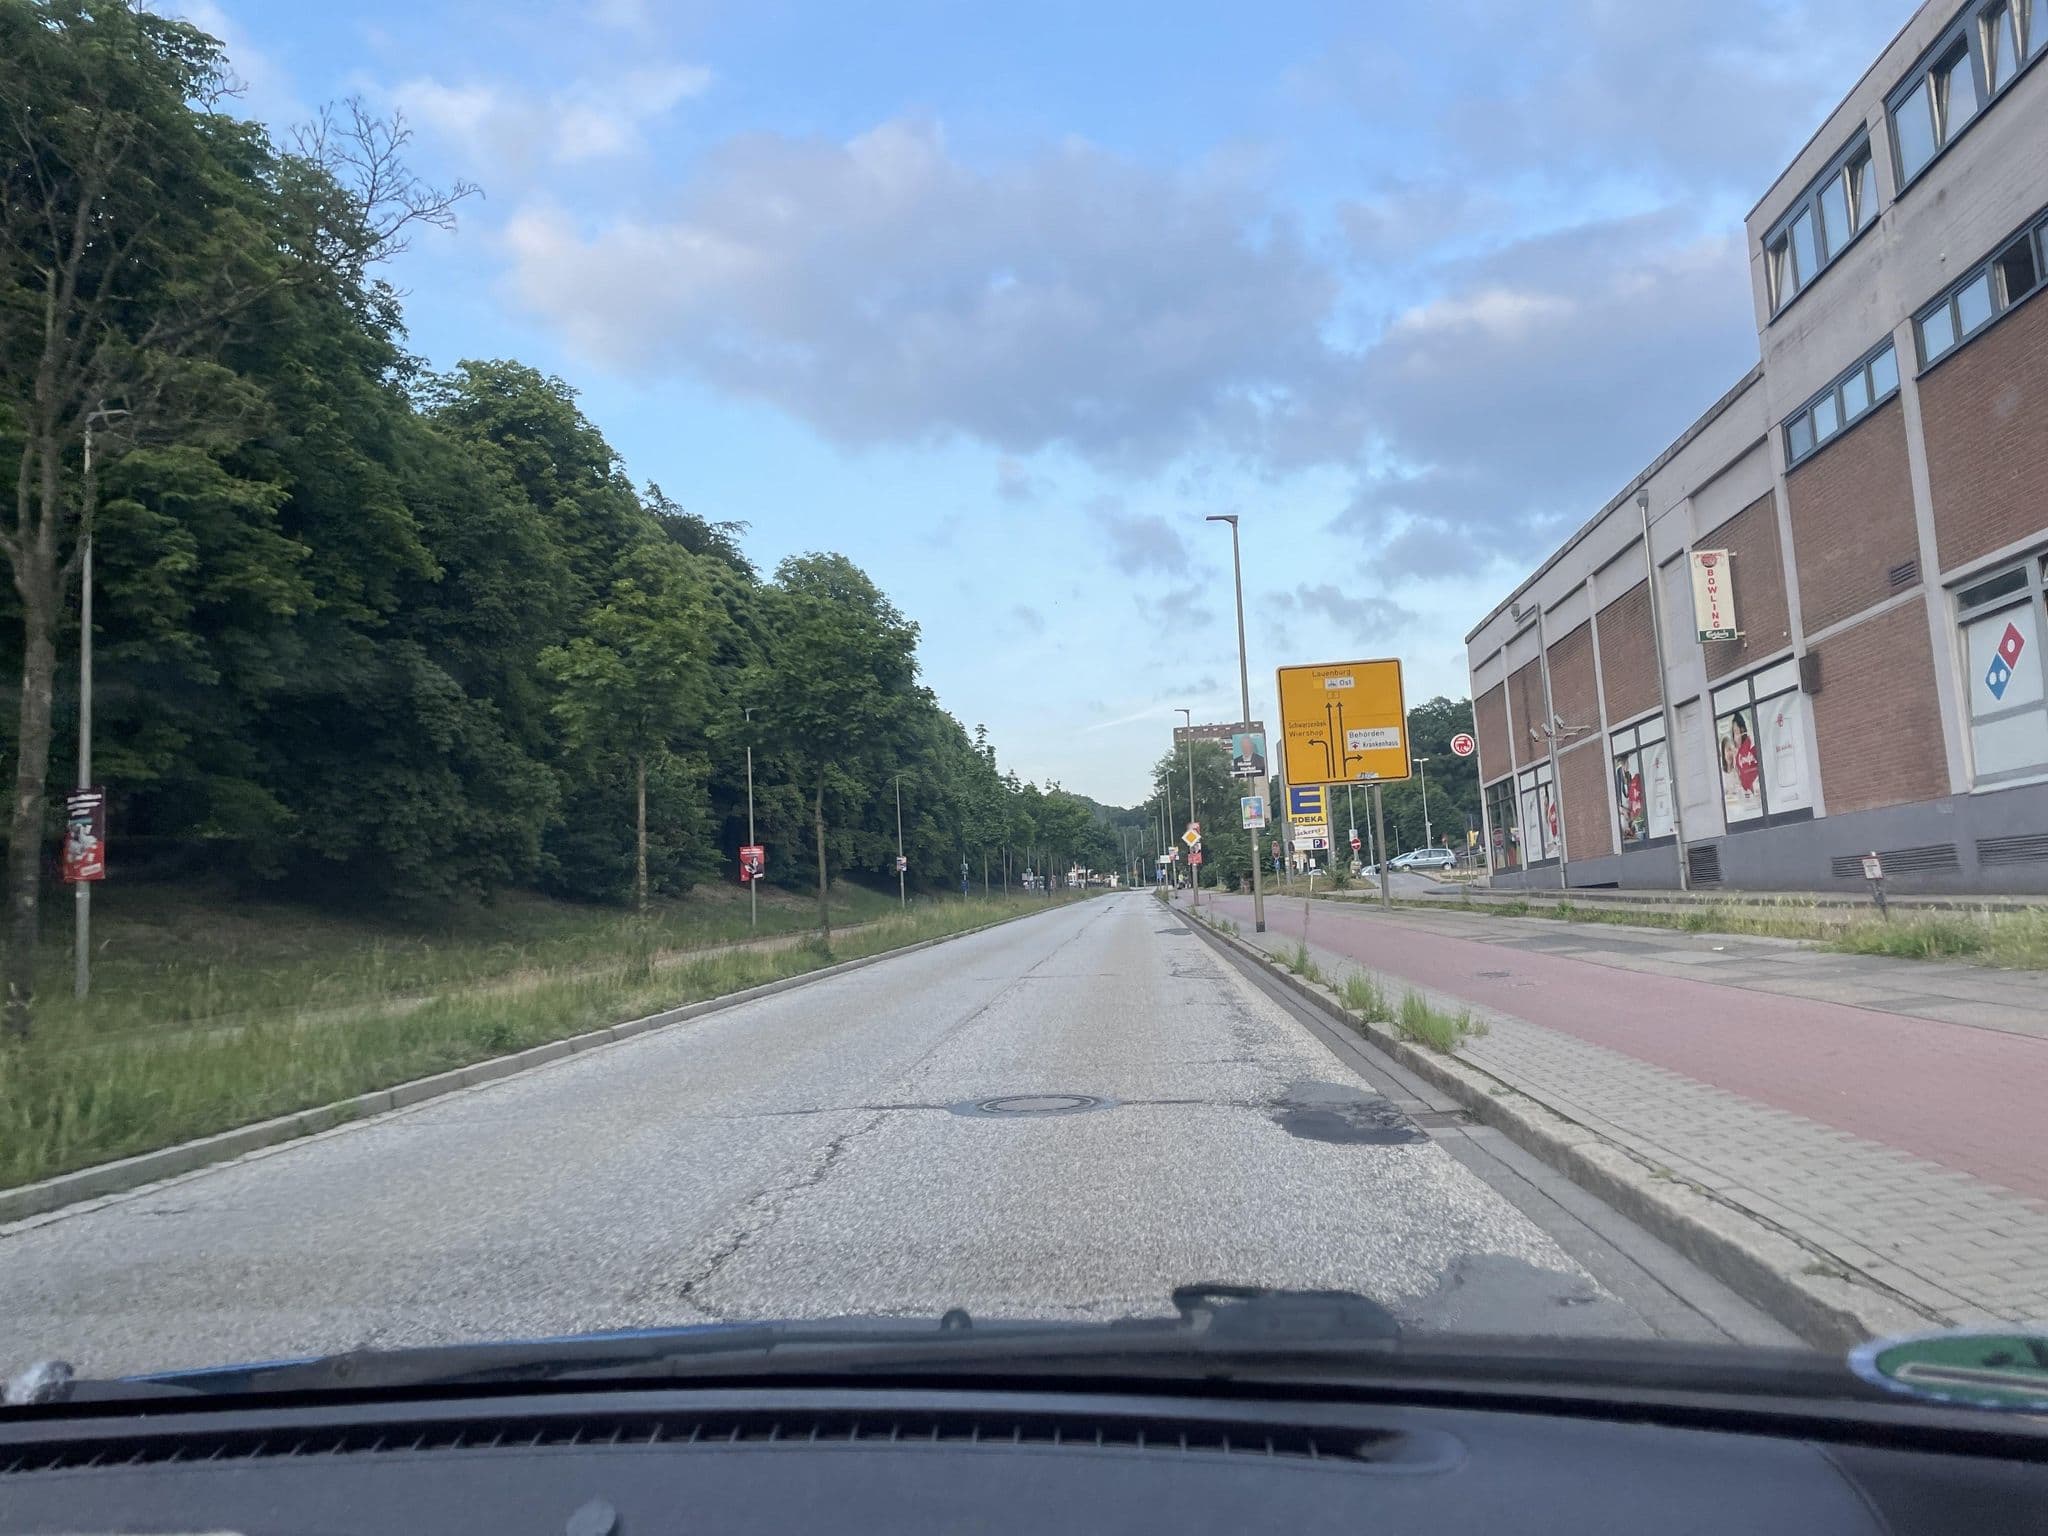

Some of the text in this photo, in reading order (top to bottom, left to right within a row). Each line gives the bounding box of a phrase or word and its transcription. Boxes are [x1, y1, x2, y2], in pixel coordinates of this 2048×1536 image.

[1707, 569, 1720, 628] BOWLING
[1349, 730, 1385, 738] Behörden
[1362, 740, 1399, 748] Krankenhaus
